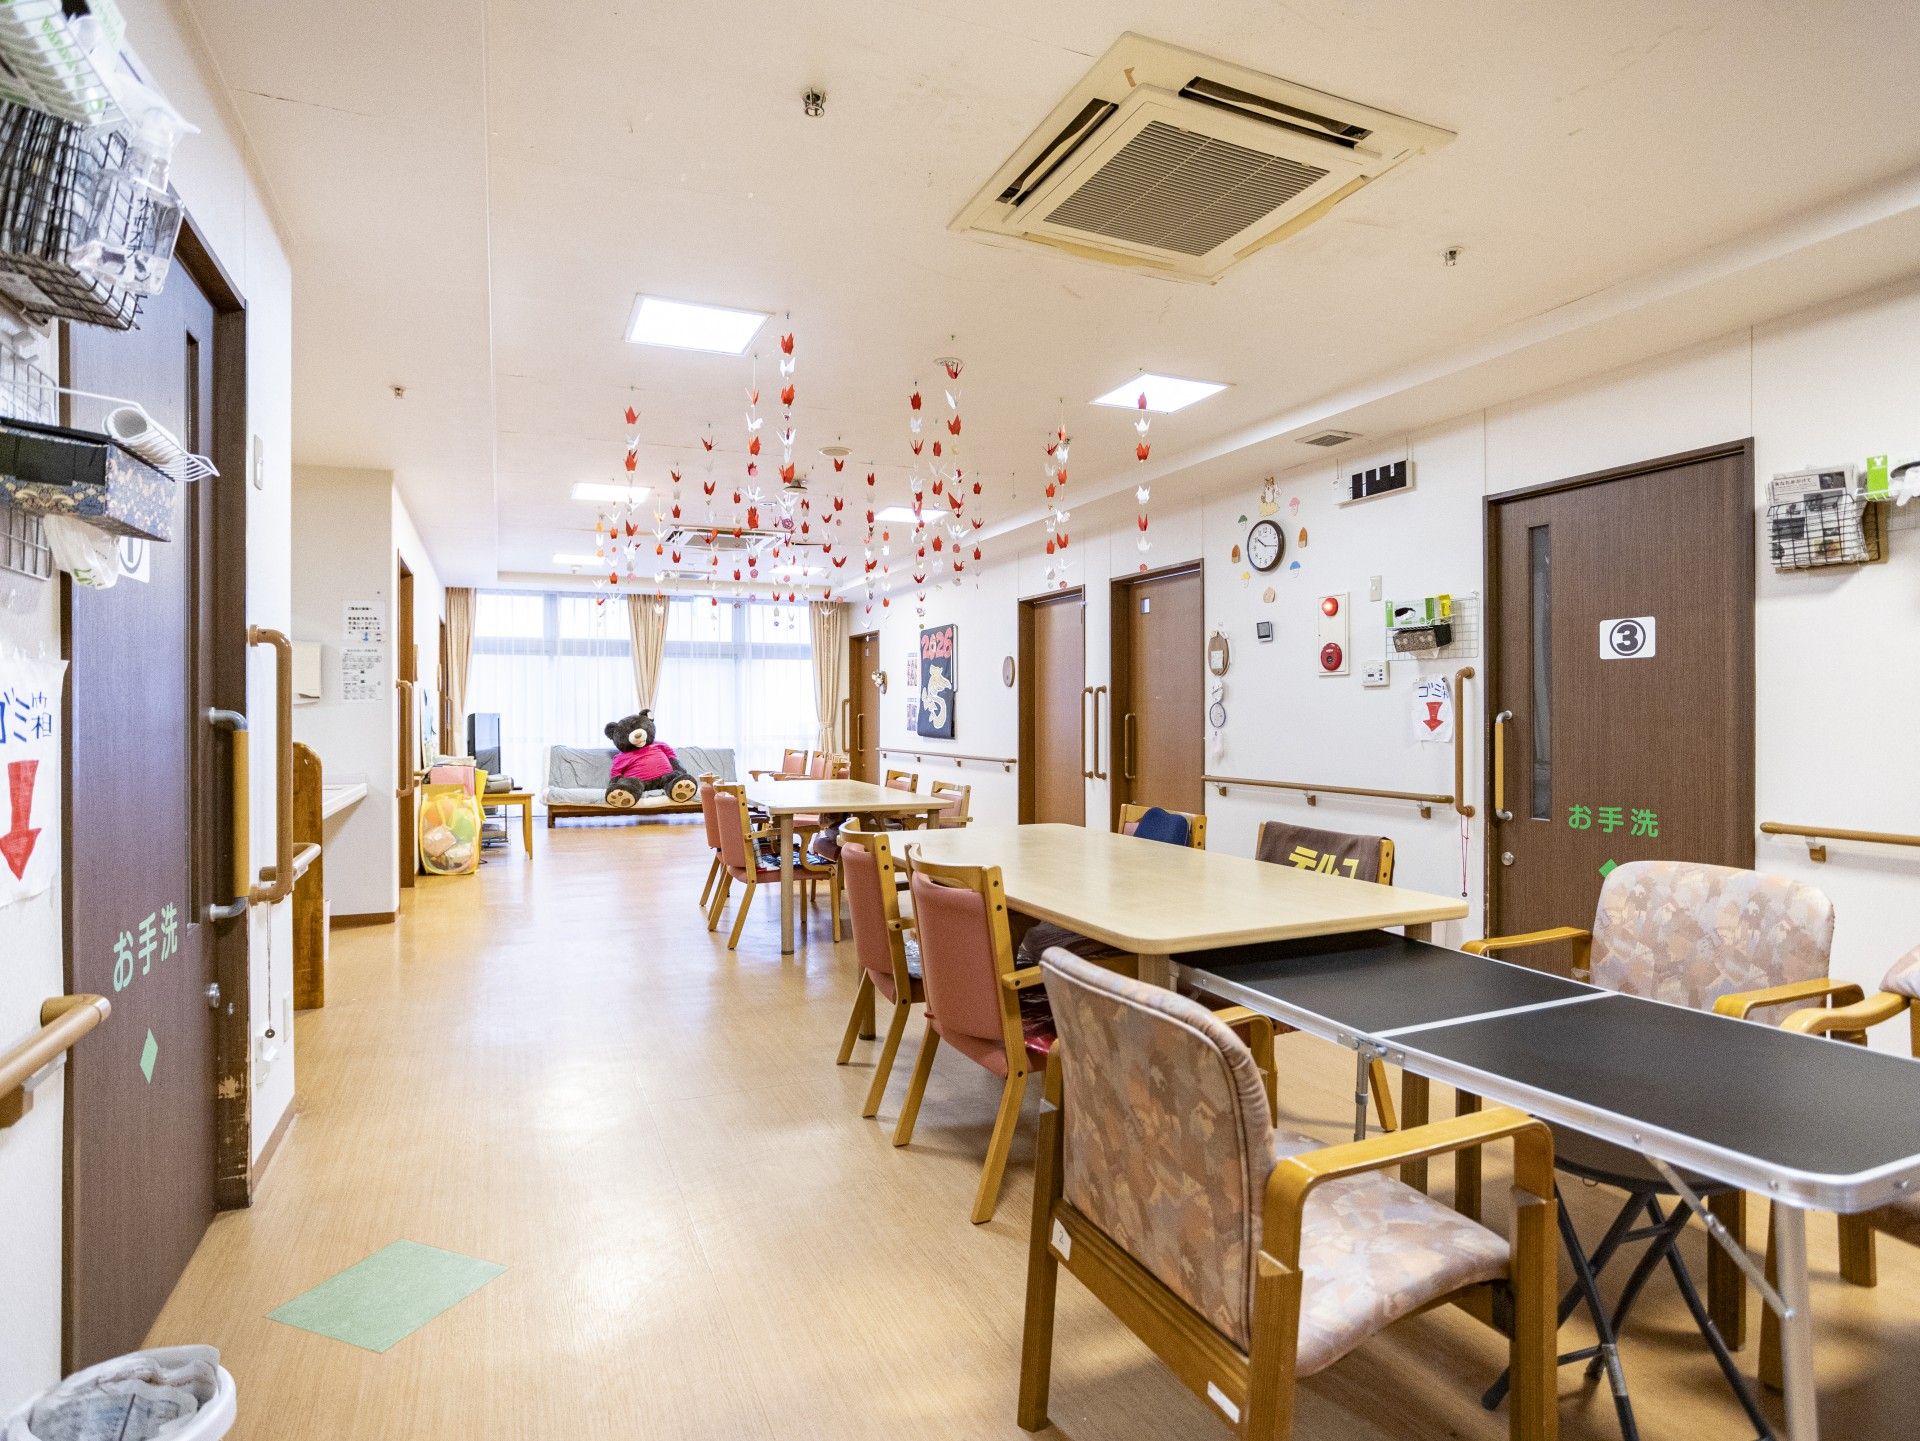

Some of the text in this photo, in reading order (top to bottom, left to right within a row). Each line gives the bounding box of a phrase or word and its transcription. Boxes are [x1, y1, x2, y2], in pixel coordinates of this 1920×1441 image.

[921, 627, 952, 660] 2026
[1568, 804, 1659, 838] お手洗
[113, 902, 178, 992] お手洗
